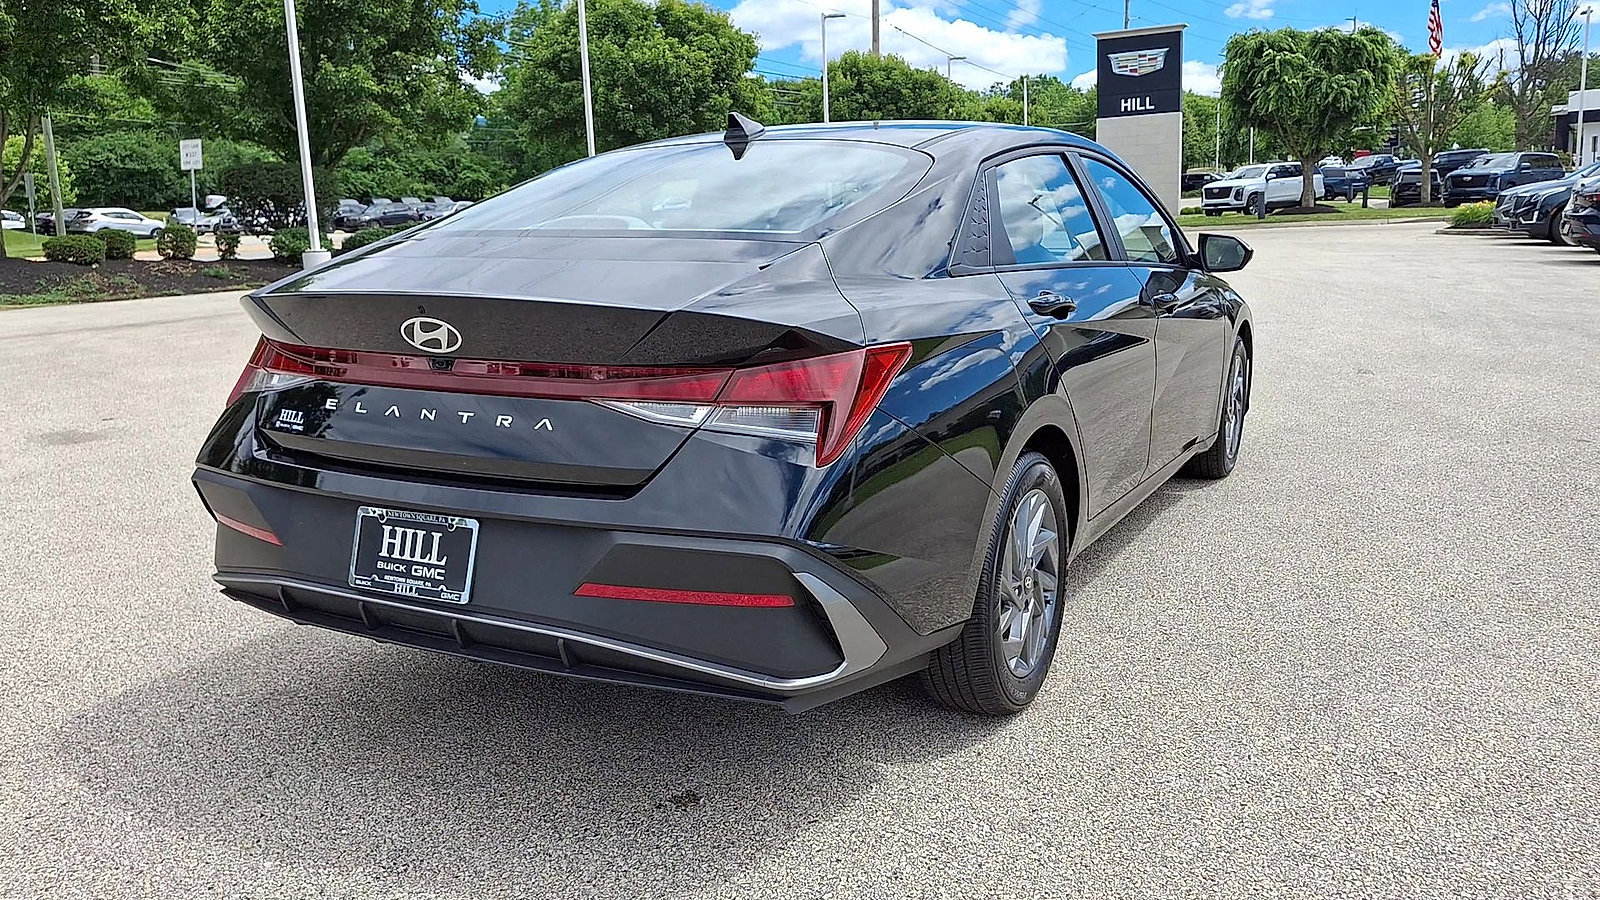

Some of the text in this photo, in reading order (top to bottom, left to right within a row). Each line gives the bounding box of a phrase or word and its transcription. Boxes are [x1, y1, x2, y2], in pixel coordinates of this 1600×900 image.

[1121, 97, 1155, 112] HILL
[279, 409, 304, 424] HILL
[325, 398, 553, 431] ELANTRA
[379, 525, 447, 565] HILL
[377, 561, 445, 580] BUICK GMC
[393, 583, 418, 596] HILL
[440, 592, 460, 601] GMC
